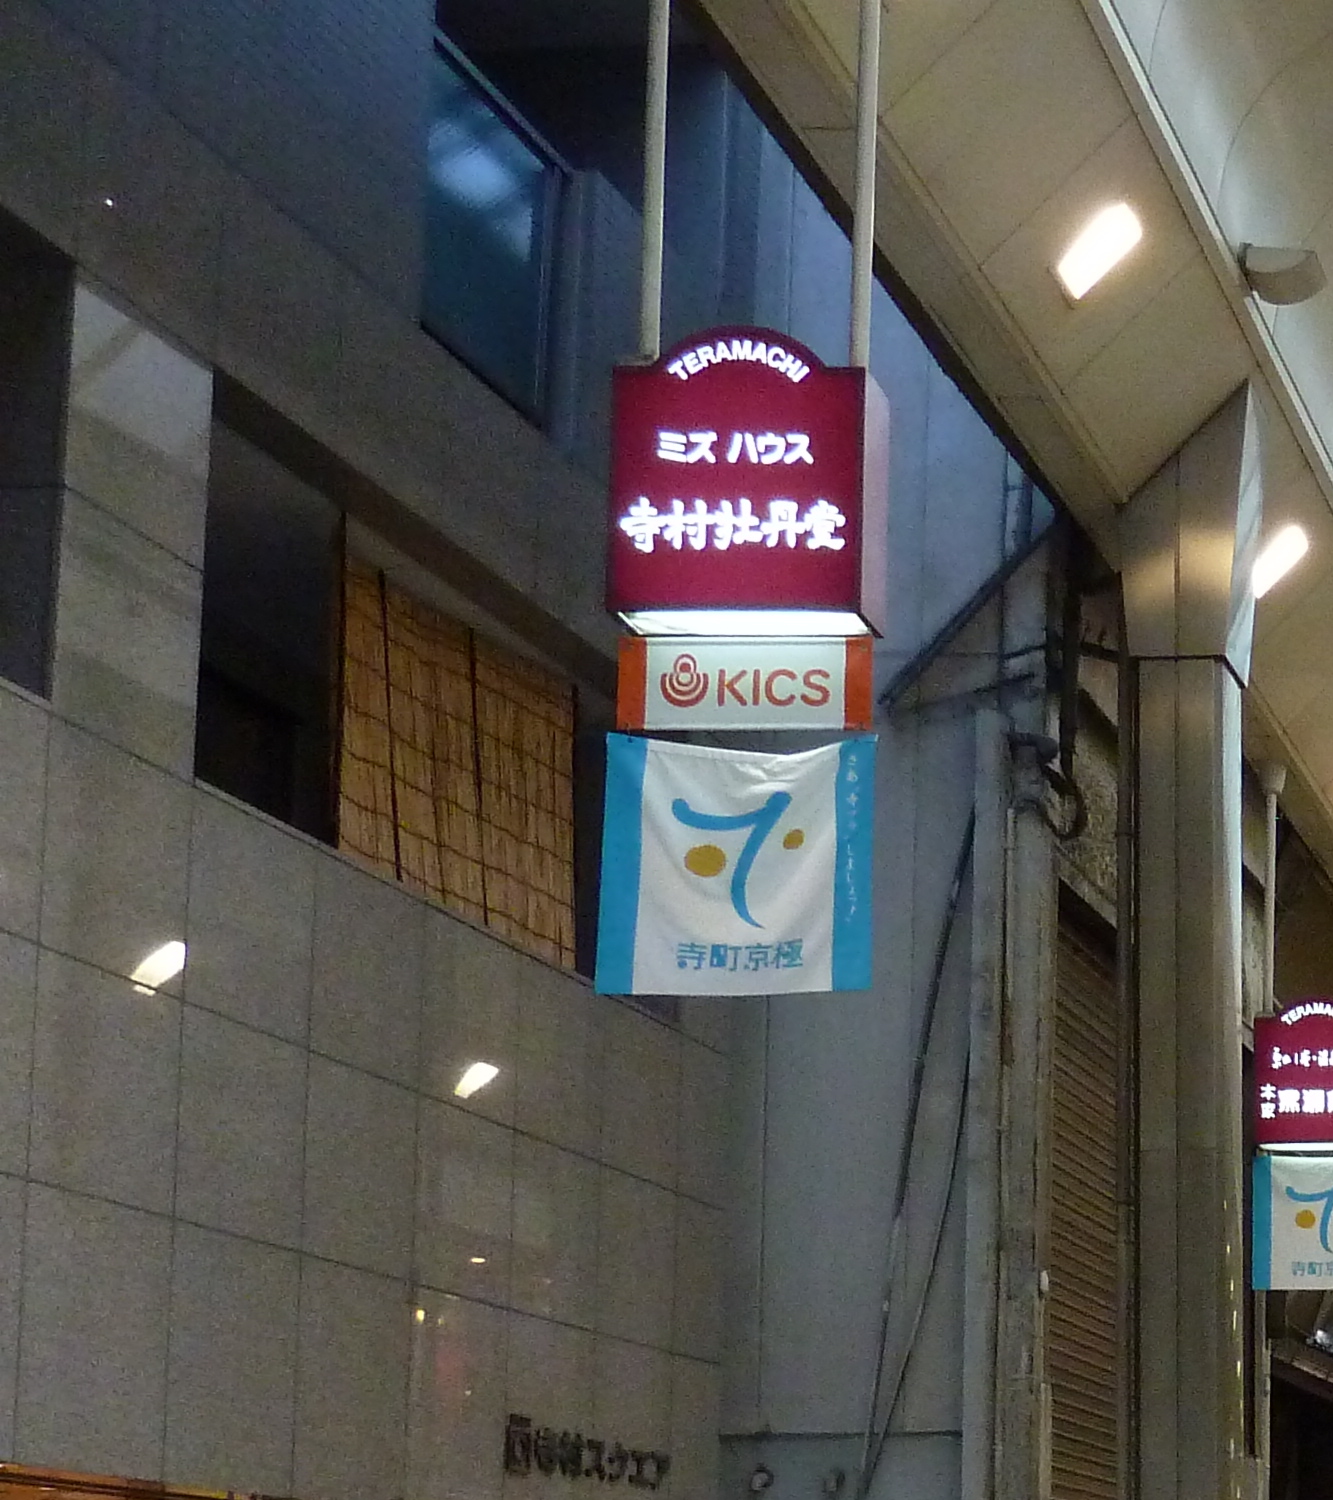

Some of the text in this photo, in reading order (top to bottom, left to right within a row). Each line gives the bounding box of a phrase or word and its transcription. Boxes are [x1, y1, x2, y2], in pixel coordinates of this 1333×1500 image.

[668, 340, 810, 383] TERAMACHI
[727, 431, 814, 465] ハウス
[619, 497, 847, 553] 寺村牡丹堂
[717, 667, 831, 707] KICS
[675, 938, 804, 972] 寺町京極
